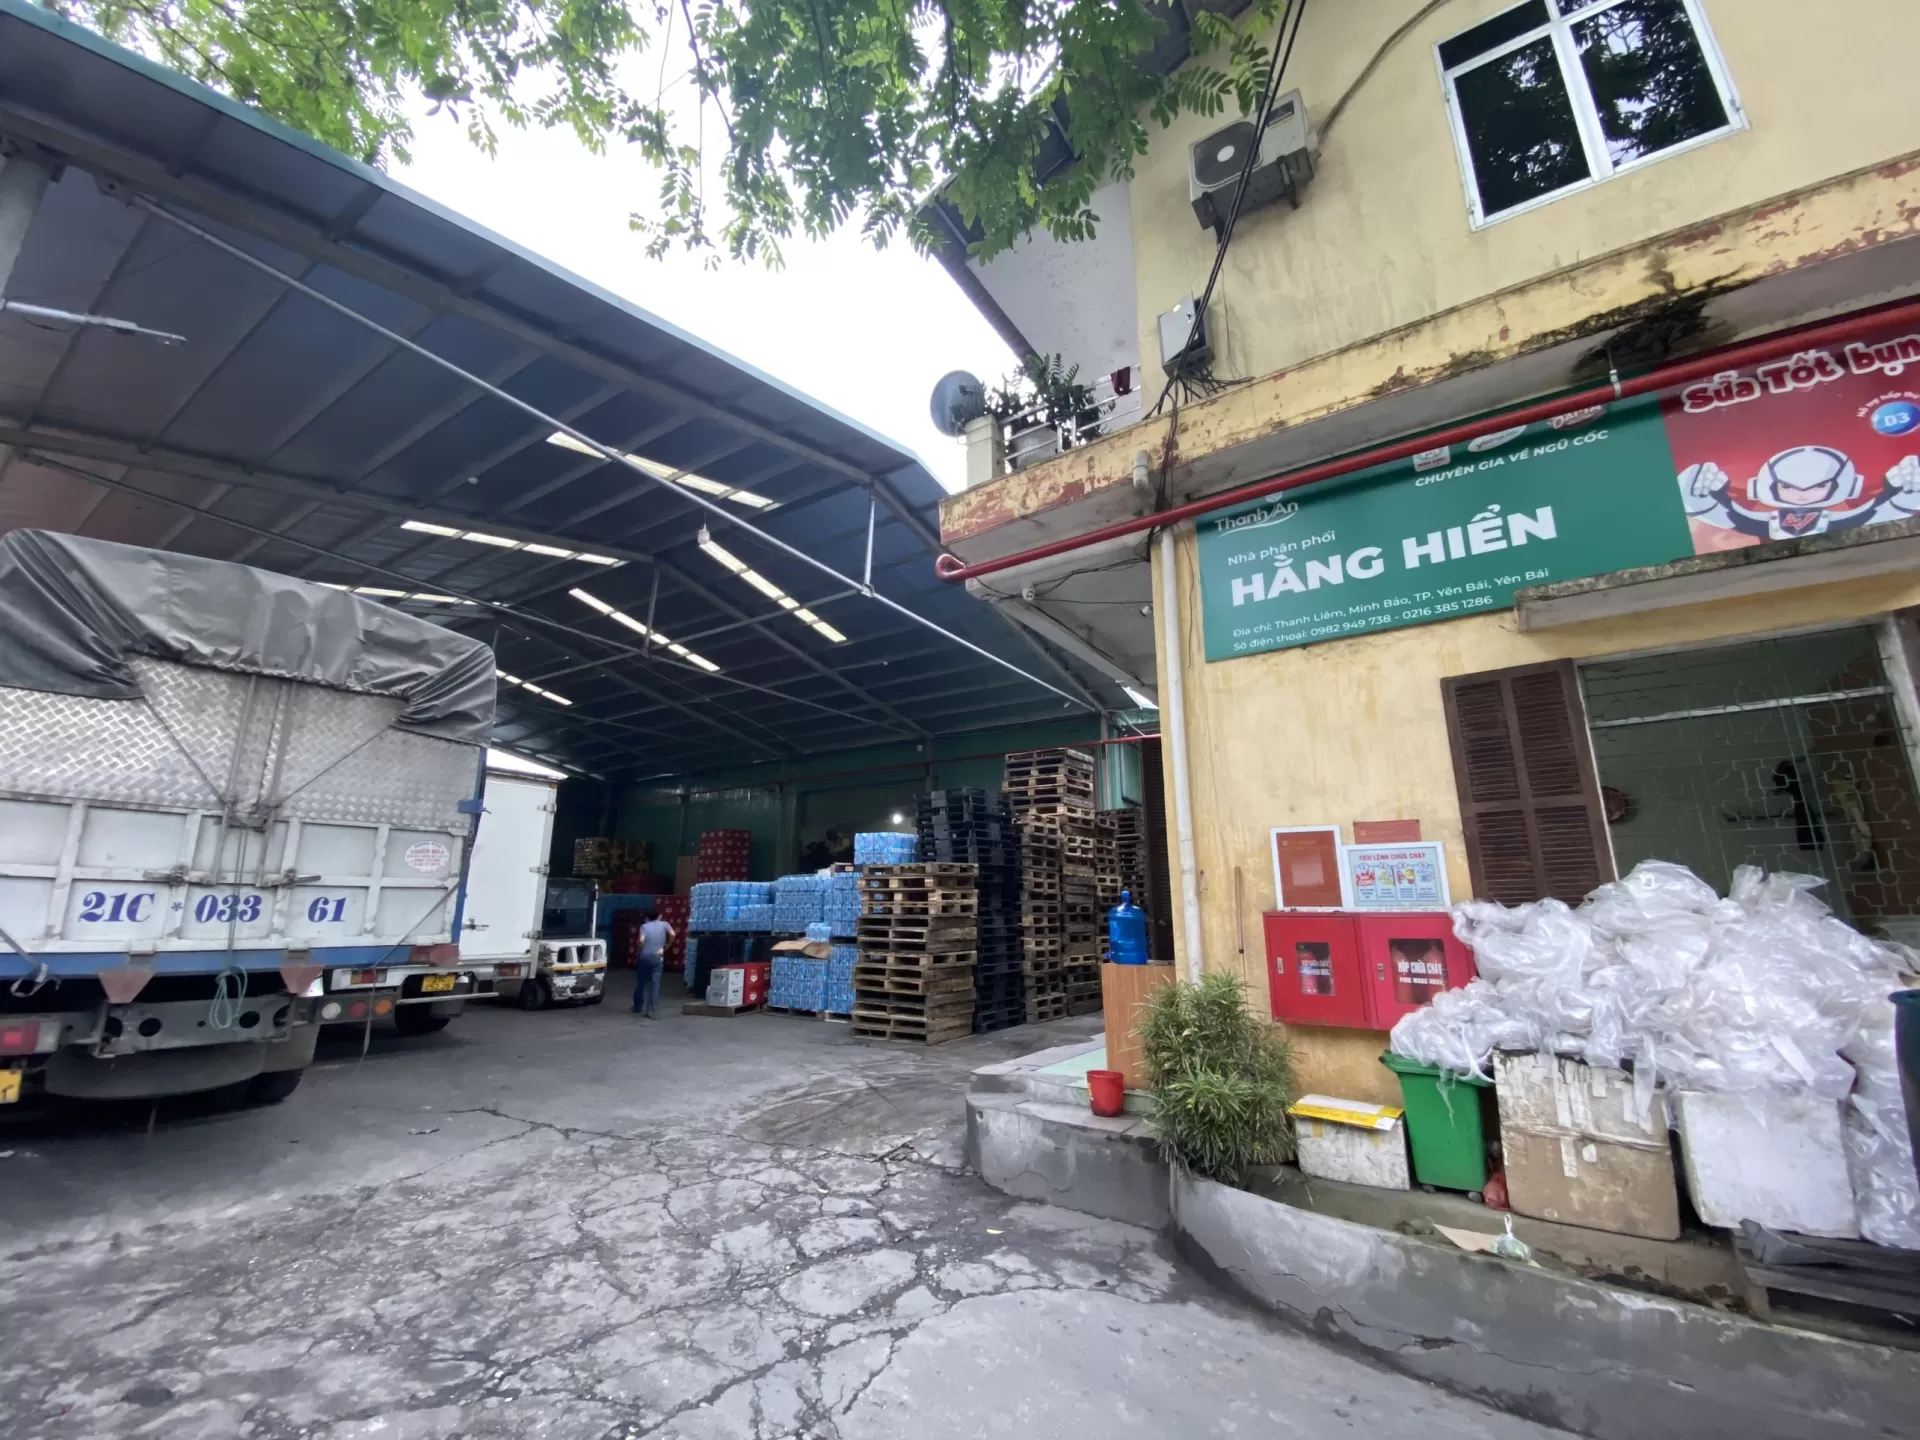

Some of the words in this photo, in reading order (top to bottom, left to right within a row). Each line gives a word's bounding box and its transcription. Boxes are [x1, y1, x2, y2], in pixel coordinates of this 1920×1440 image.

[1681, 370, 1761, 413] Sữa
[1756, 350, 1844, 394] Tốt
[1884, 412, 1910, 427] D3
[1415, 465, 1475, 487] CHUYÊN
[1478, 457, 1505, 471] GIA
[1509, 448, 1529, 463] VỀ
[1533, 439, 1568, 457] NGŨ
[1572, 430, 1609, 446] CỐC
[1214, 509, 1267, 532] Thanh
[1228, 551, 1256, 566] Nhà
[1260, 541, 1297, 560] phân
[1302, 530, 1336, 550] phối
[1231, 546, 1385, 607] HẰNG
[1402, 504, 1557, 569] HIỂN
[1233, 627, 1251, 638] Địa
[1274, 615, 1311, 629] Thanh
[1314, 609, 1346, 622] Liêm,
[1349, 602, 1380, 615] Minh
[1383, 596, 1411, 608] Bảo,
[1414, 591, 1434, 602] TP.
[1437, 585, 1462, 598] Yên
[1466, 579, 1492, 593] Bái,
[1494, 574, 1521, 587] Yên
[1525, 567, 1549, 581] Bái
[1233, 640, 1247, 651] Số
[1249, 636, 1274, 649] điện
[1310, 624, 1340, 637] 0982
[1343, 619, 1366, 631] 949
[1368, 614, 1392, 626] 738
[1402, 608, 1432, 620] 0216
[1434, 602, 1459, 614] 385
[1462, 595, 1493, 608] 1286
[77, 892, 155, 923] 21C
[195, 894, 262, 924] 033
[307, 896, 347, 923] 61
